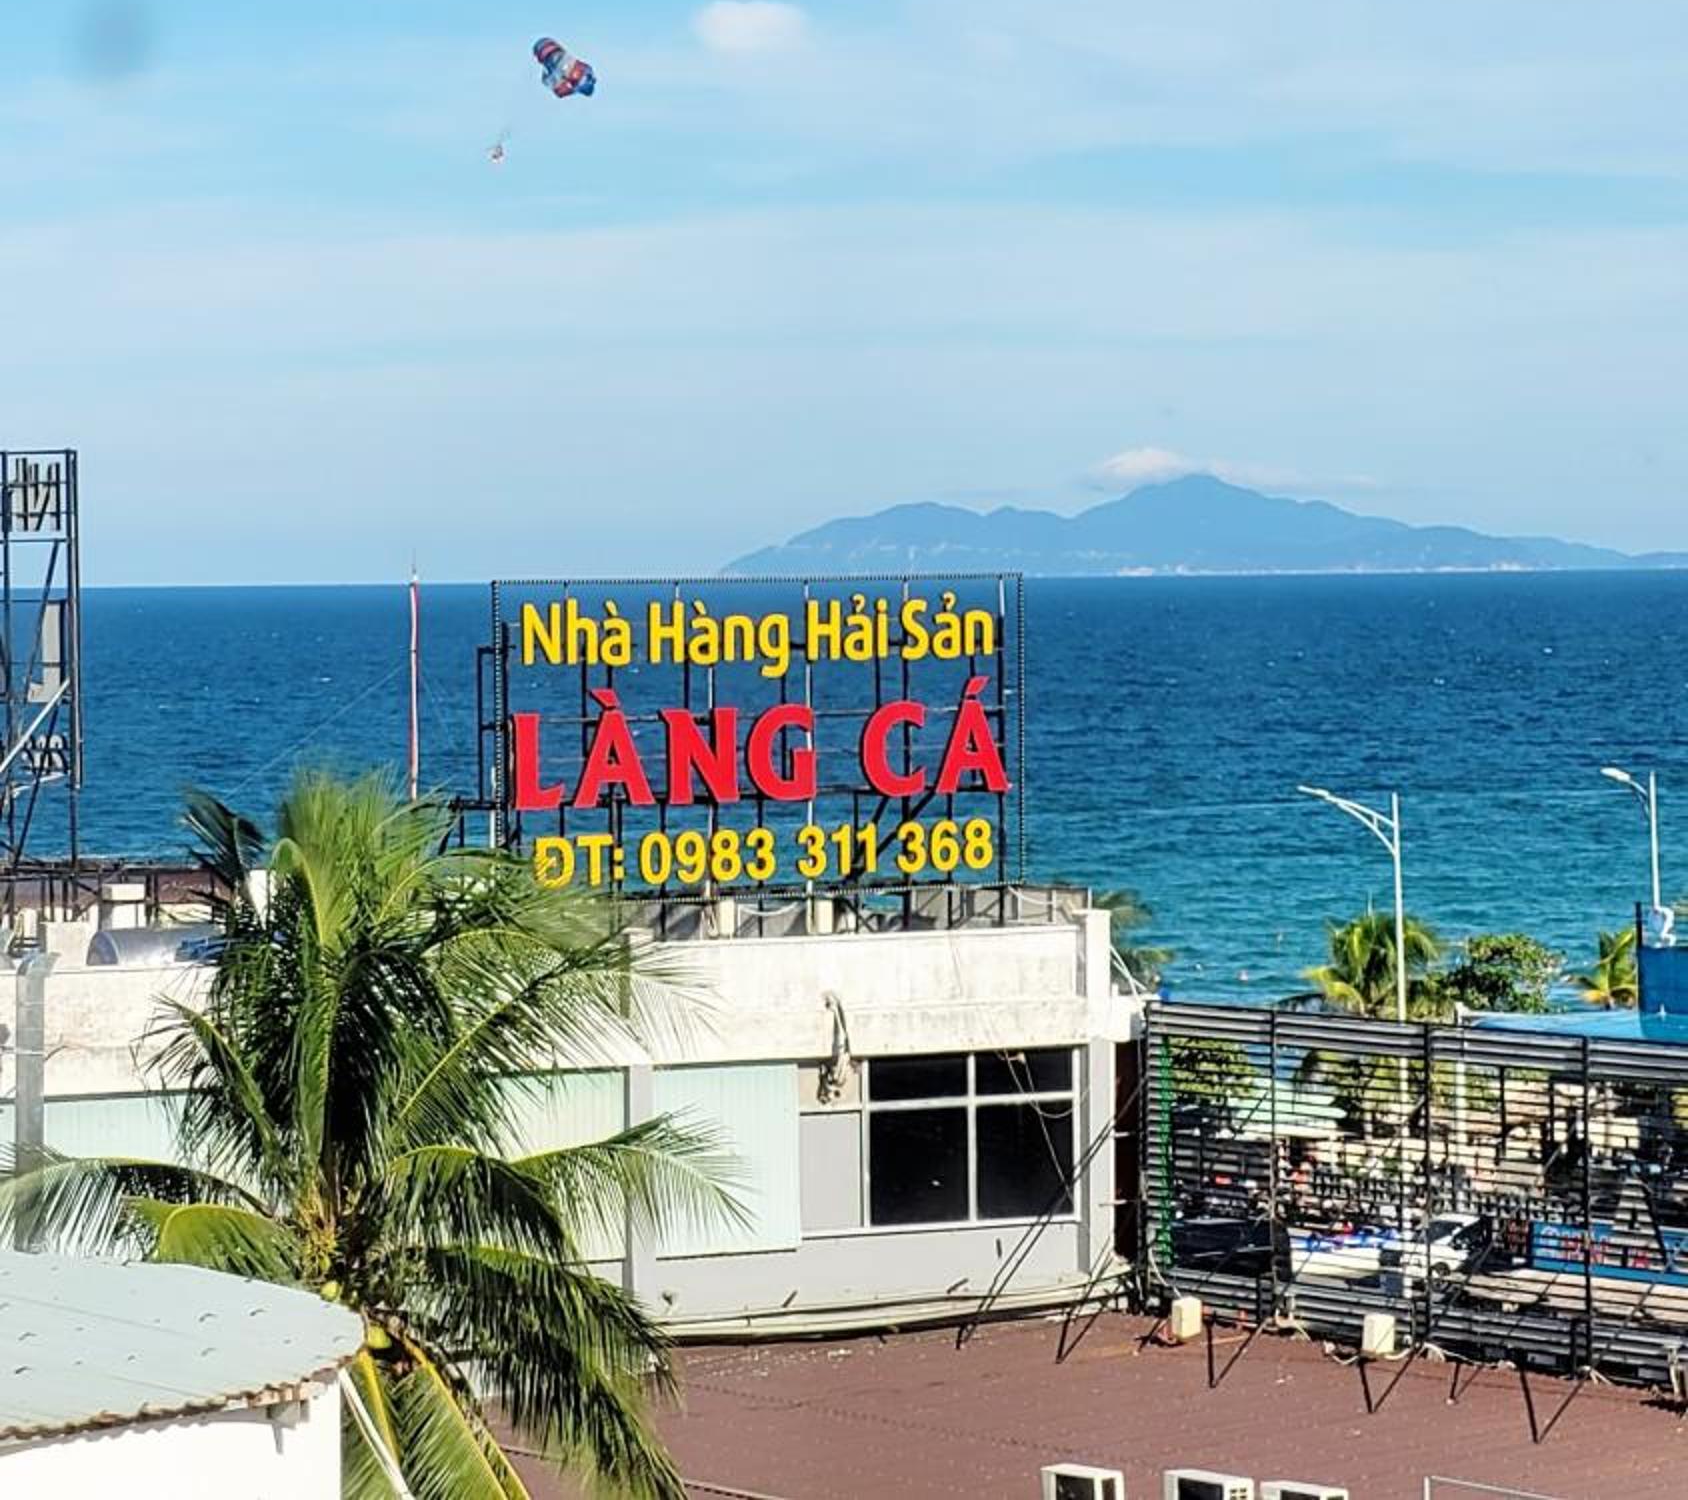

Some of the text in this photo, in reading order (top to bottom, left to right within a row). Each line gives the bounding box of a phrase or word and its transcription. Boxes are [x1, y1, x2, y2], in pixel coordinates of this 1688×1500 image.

[523, 592, 993, 677] Nhà Hàng Hải Sản
[514, 677, 1008, 809] LÀNG CÁ
[535, 819, 993, 888] ĐT: 0983 311 368
